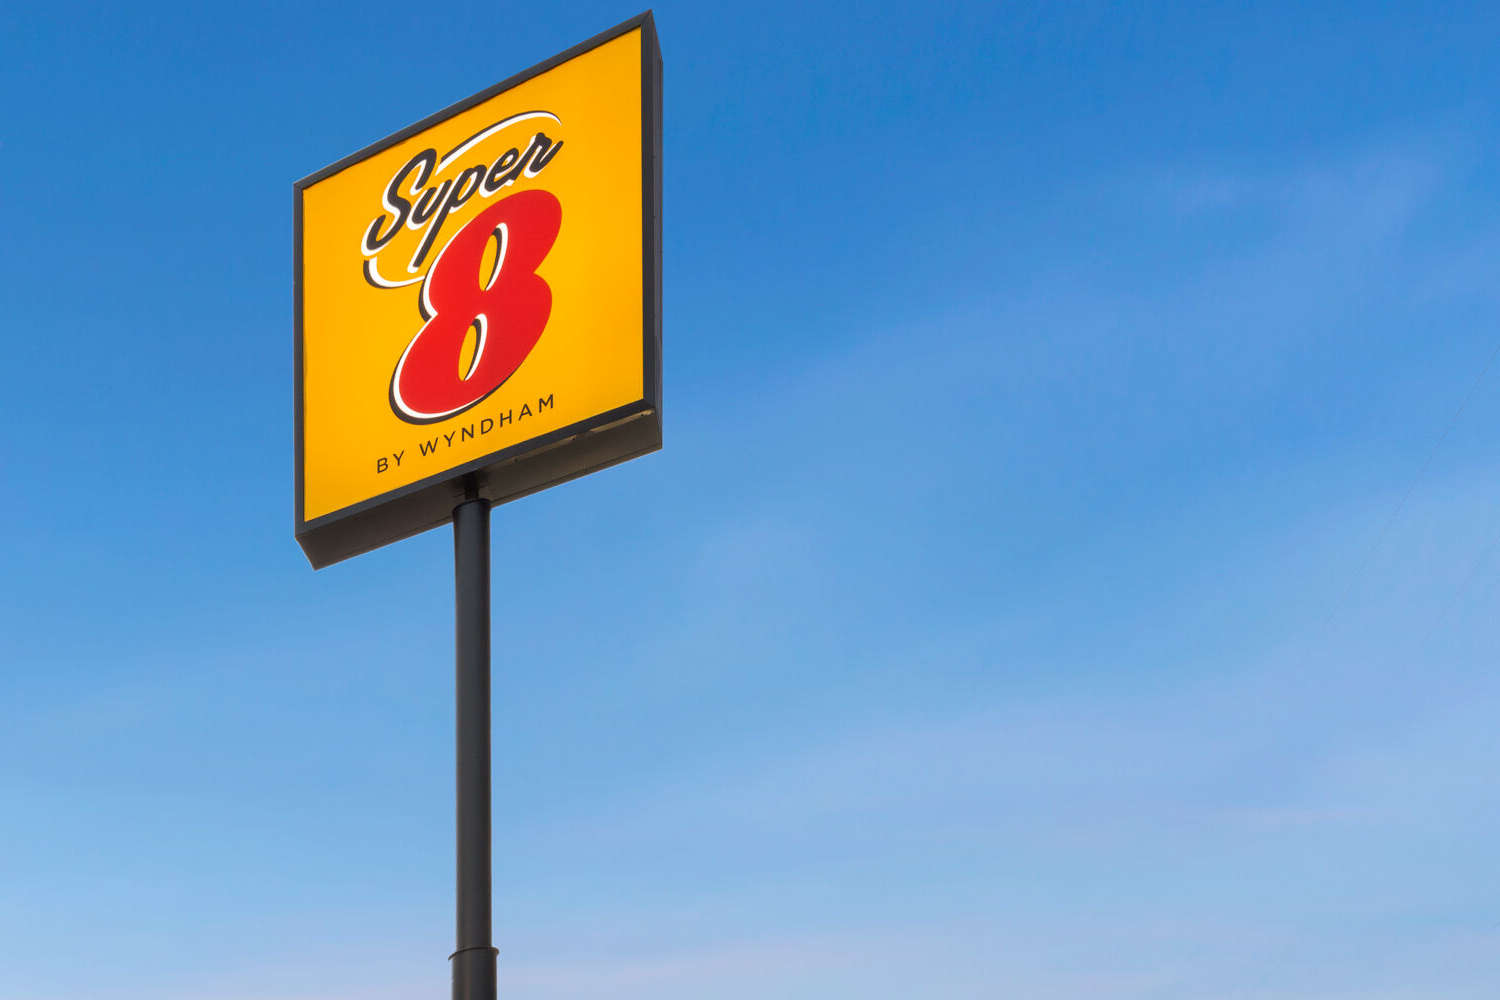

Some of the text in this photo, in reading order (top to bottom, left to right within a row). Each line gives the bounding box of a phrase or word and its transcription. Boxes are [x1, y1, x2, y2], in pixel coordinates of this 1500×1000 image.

[361, 131, 564, 274] Super
[388, 189, 563, 425] 8
[376, 393, 554, 474] BY WYNDHAM
